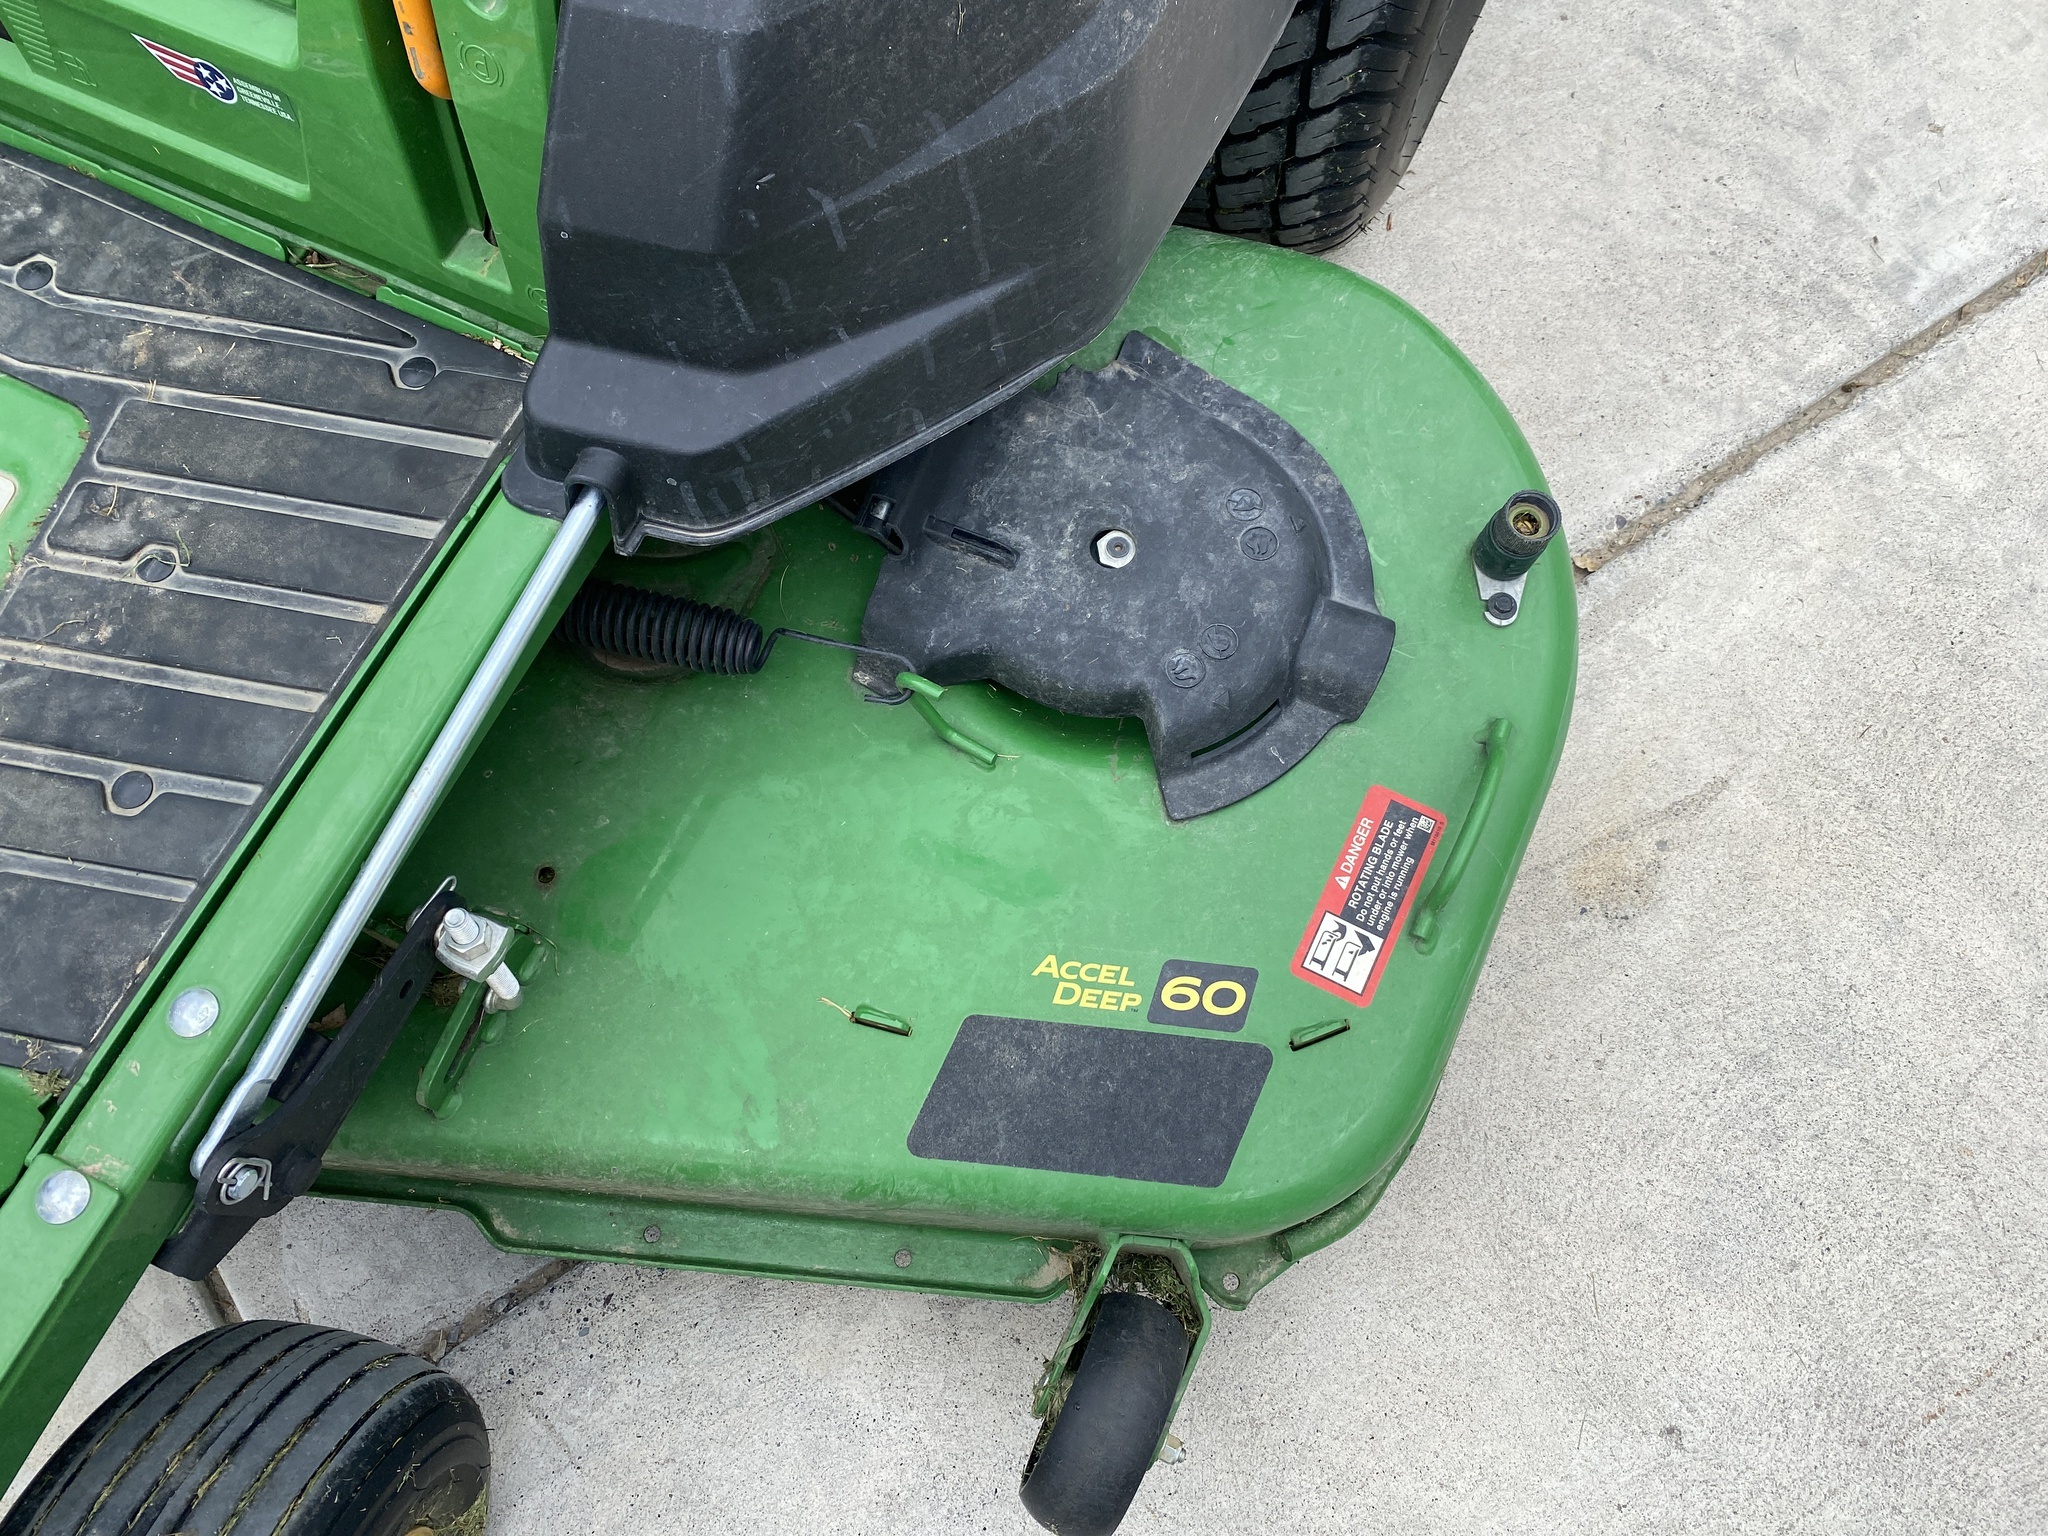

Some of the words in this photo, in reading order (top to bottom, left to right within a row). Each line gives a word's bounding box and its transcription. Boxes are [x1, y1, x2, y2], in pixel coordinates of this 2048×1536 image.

[233, 77, 272, 98] ASSEMBLED
[1393, 820, 1407, 837] feet
[1404, 817, 1419, 840] when
[1340, 817, 1374, 874] DANGER
[1390, 837, 1398, 848] or
[1348, 856, 1378, 909] ROTATING
[1372, 820, 1394, 855] BLADE
[1376, 849, 1394, 876] hands
[1391, 840, 1409, 870] mower
[1370, 876, 1382, 893] put
[1382, 871, 1395, 889] into
[1364, 892, 1375, 908] not
[1376, 901, 1394, 931] engine
[1388, 891, 1398, 900] is
[1393, 856, 1415, 890] running
[1379, 889, 1387, 899] or
[1356, 909, 1367, 922] Do
[1367, 900, 1382, 926] under
[1031, 954, 1135, 986] ACCEL
[1052, 981, 1142, 1012] DEEP
[1160, 975, 1247, 1016] 60
